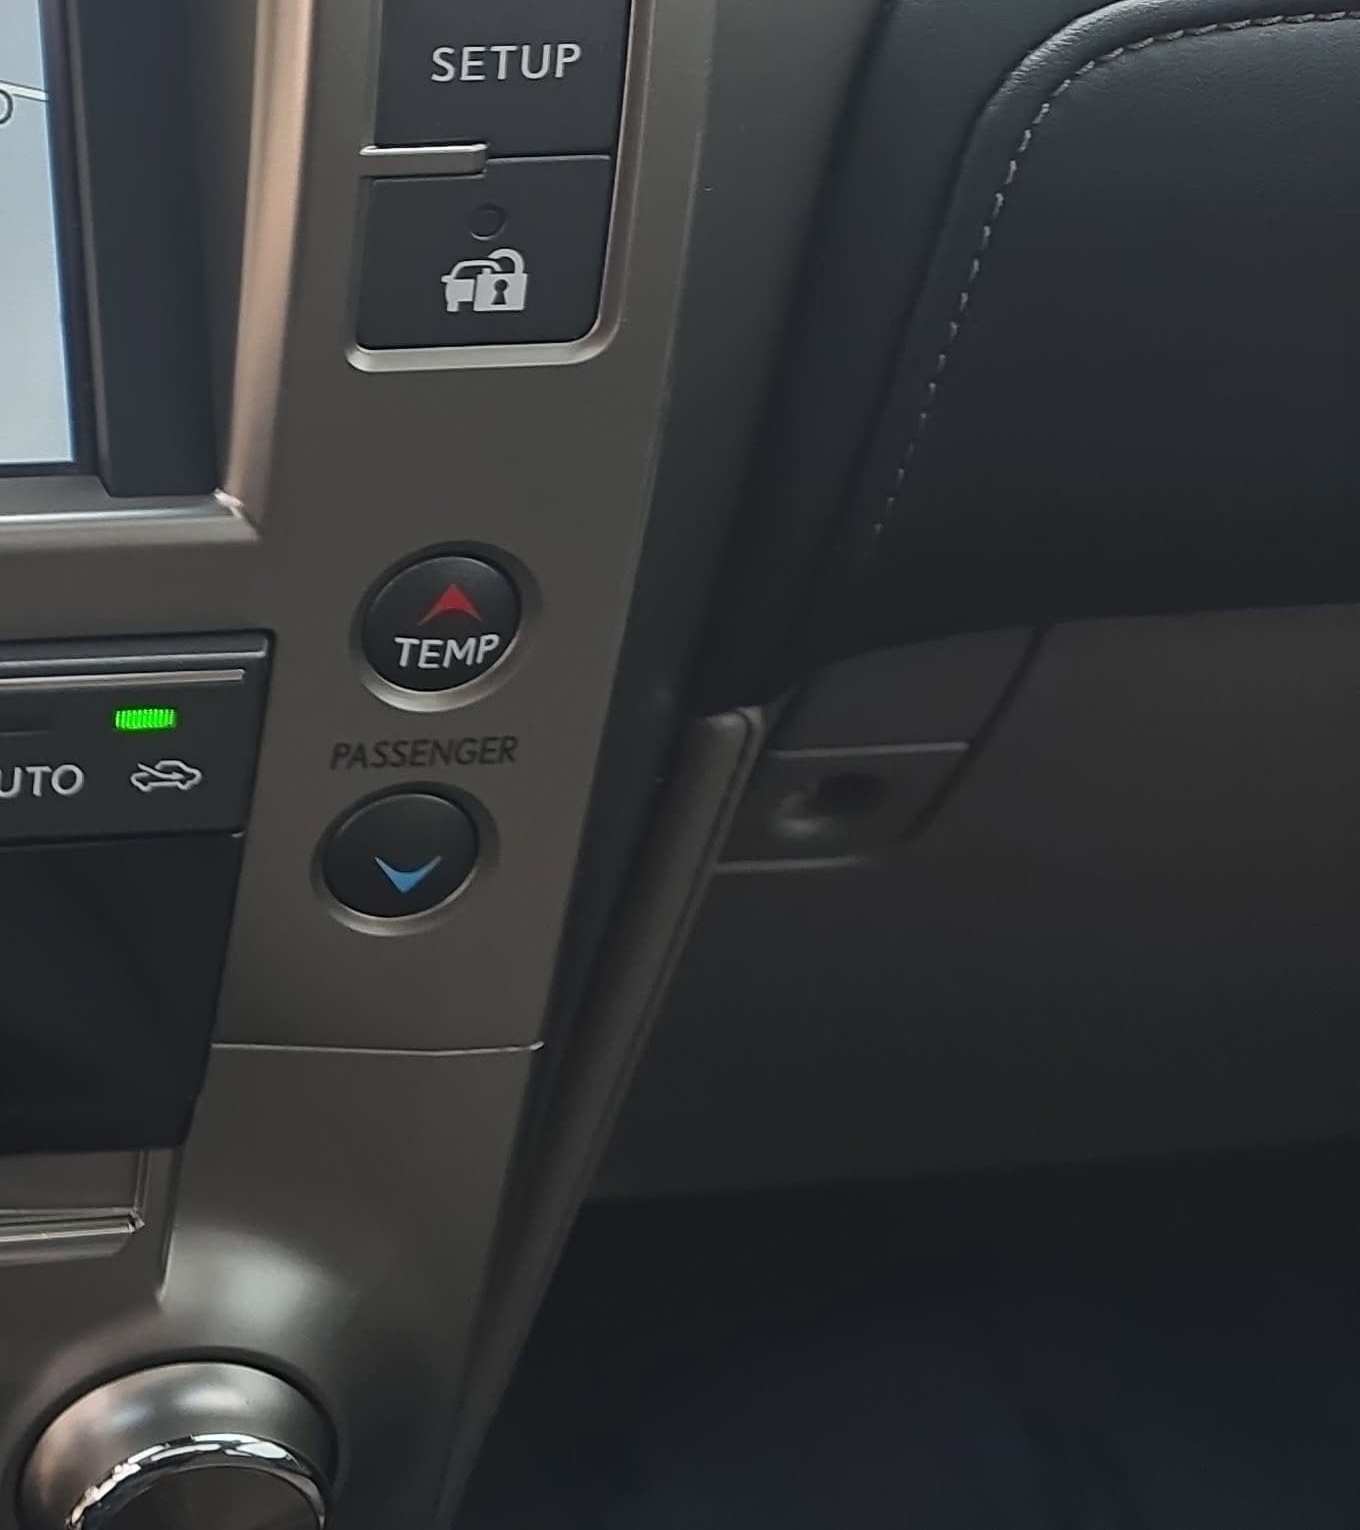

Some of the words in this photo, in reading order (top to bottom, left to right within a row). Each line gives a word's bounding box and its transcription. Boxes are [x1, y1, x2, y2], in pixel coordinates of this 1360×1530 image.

[431, 42, 583, 83] SETUP
[393, 632, 501, 671] TEMP
[330, 734, 519, 770] PASSENGER
